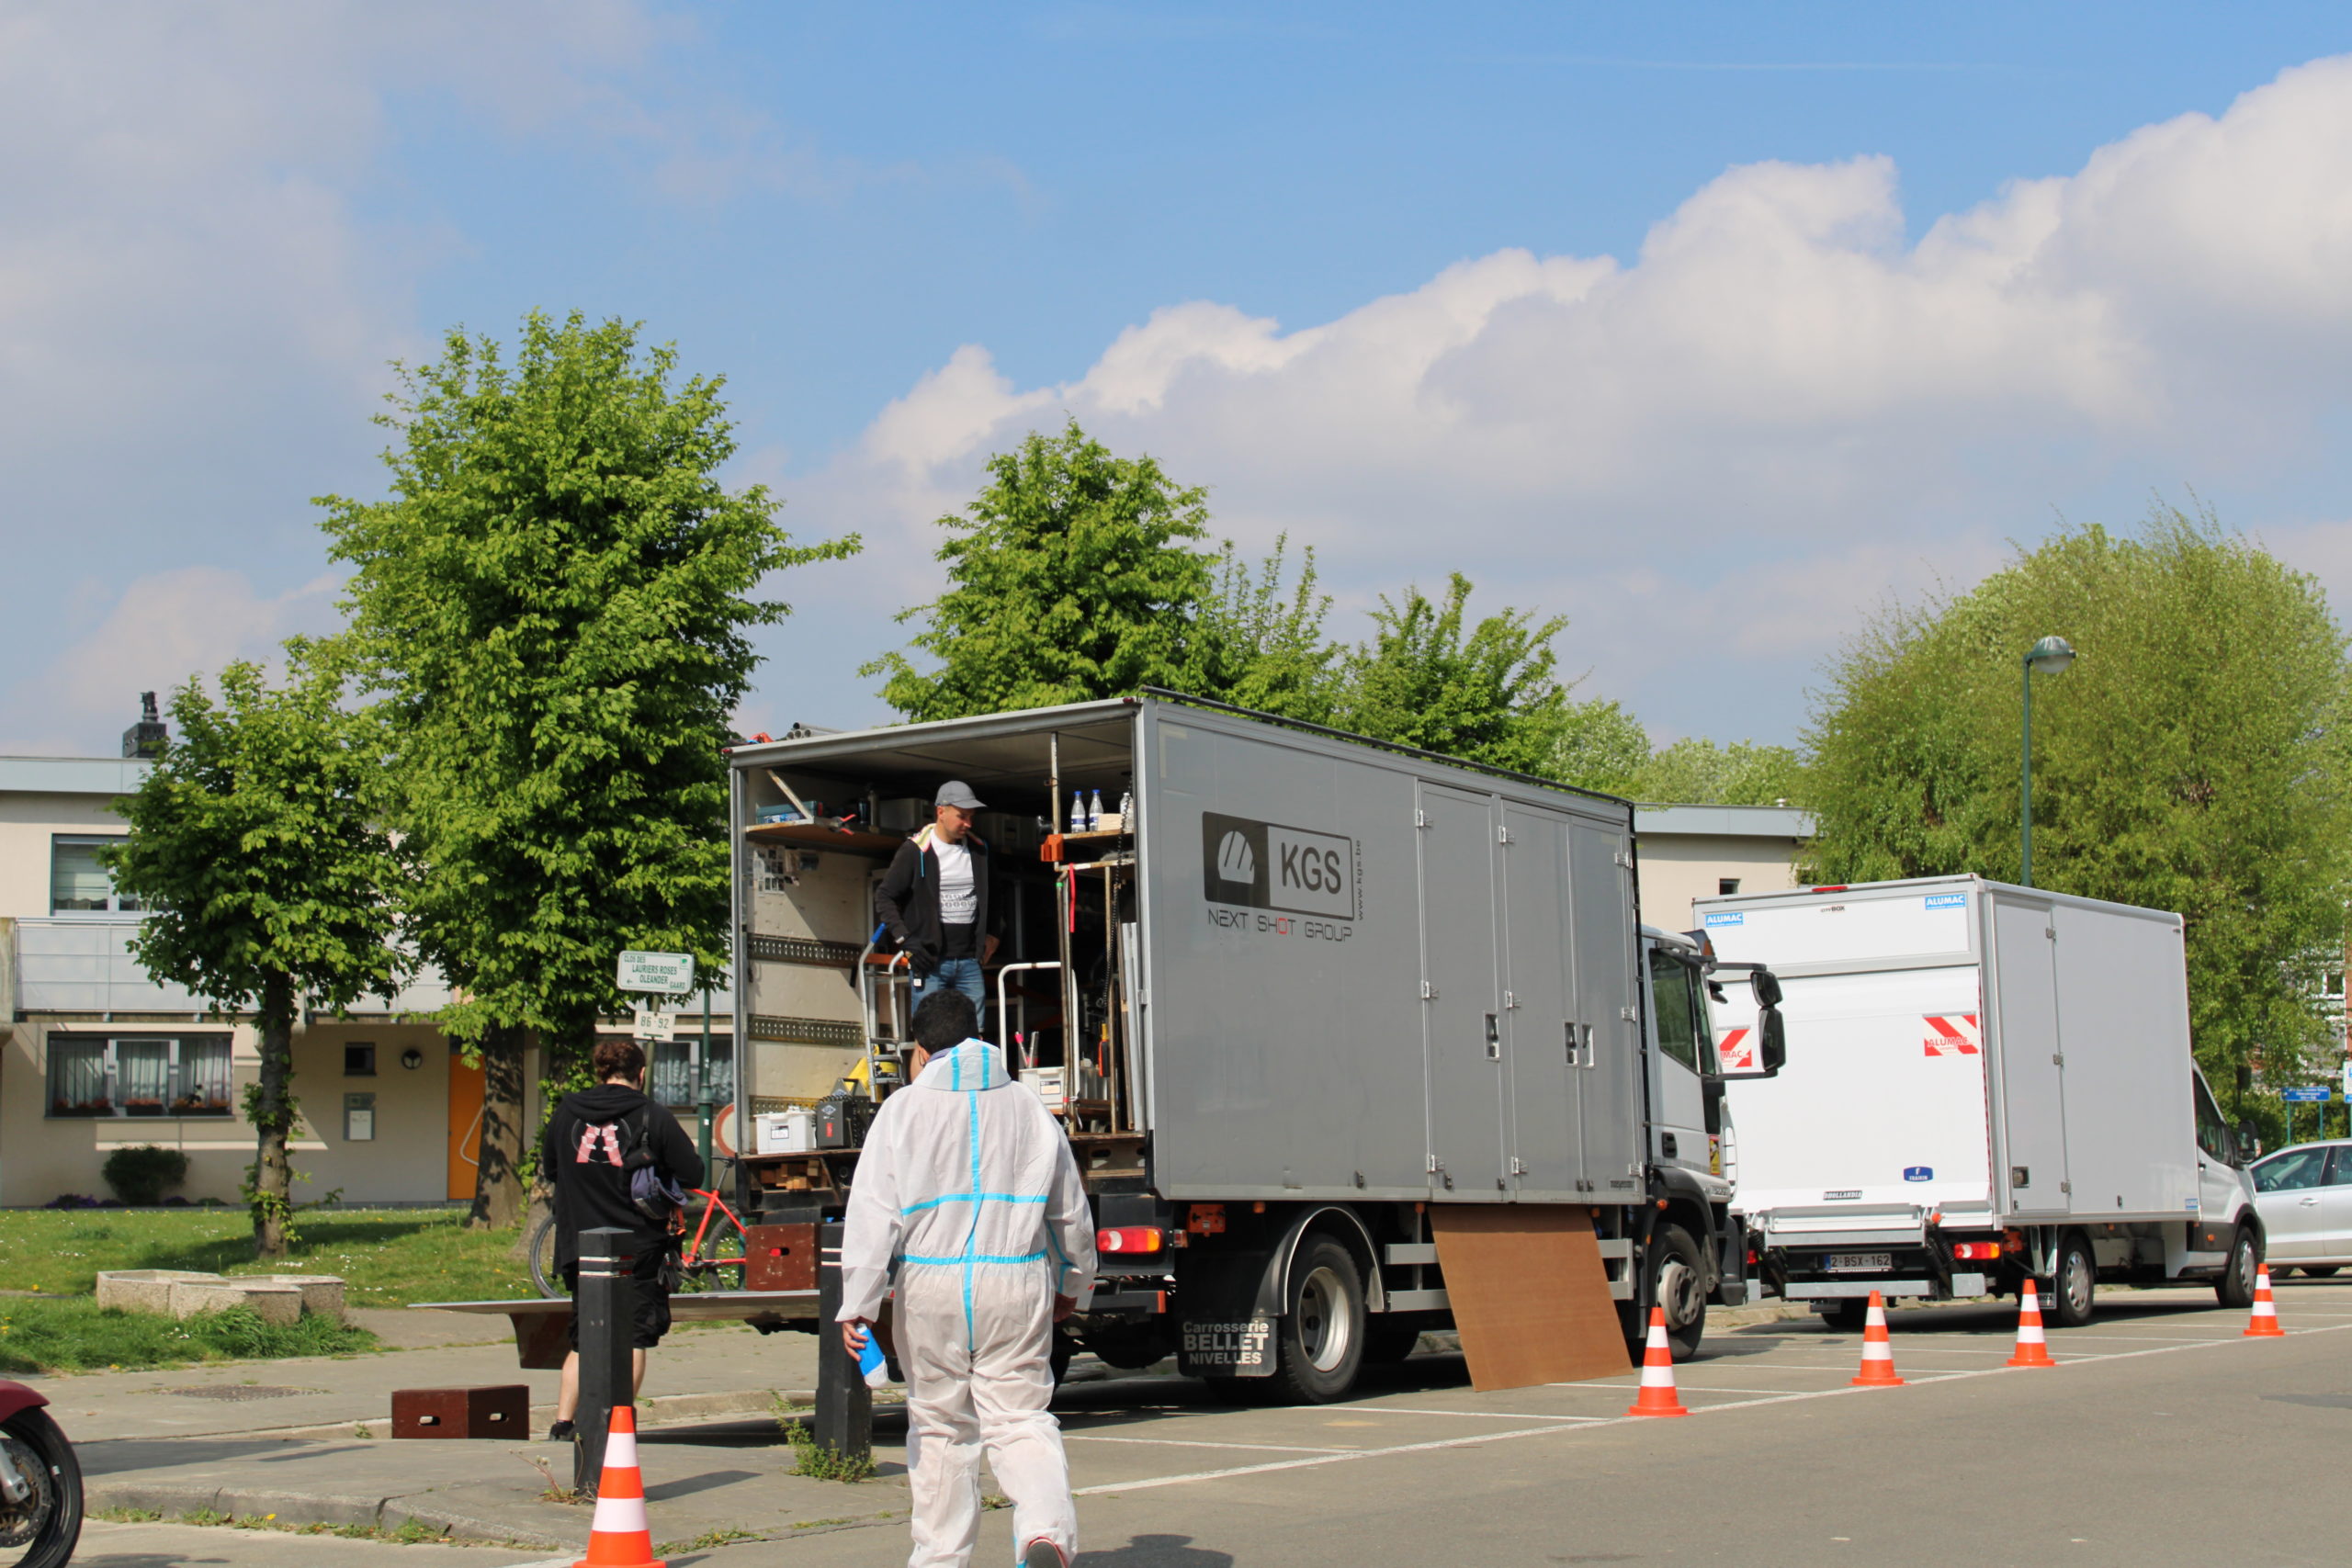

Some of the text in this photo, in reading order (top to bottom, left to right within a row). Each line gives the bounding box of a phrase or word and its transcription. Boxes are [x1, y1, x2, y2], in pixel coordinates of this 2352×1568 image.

[1282, 842, 1341, 895] KGS
[1355, 840, 1363, 920] www.kgs.be
[1926, 895, 1964, 905] ALUMAC
[1707, 913, 1742, 923] ALUMAC
[1208, 908, 1352, 942] NEXT SHOT GROUP
[632, 964, 677, 976] LAURIERS ROSES
[639, 974, 668, 985] OLEANDER
[641, 1016, 651, 1027] 86
[1928, 1037, 1968, 1046] ALUMAC
[1182, 1320, 1269, 1333] Carrosserie
[1183, 1333, 1269, 1351] BELLET
[1188, 1352, 1262, 1365] NIVELLES
